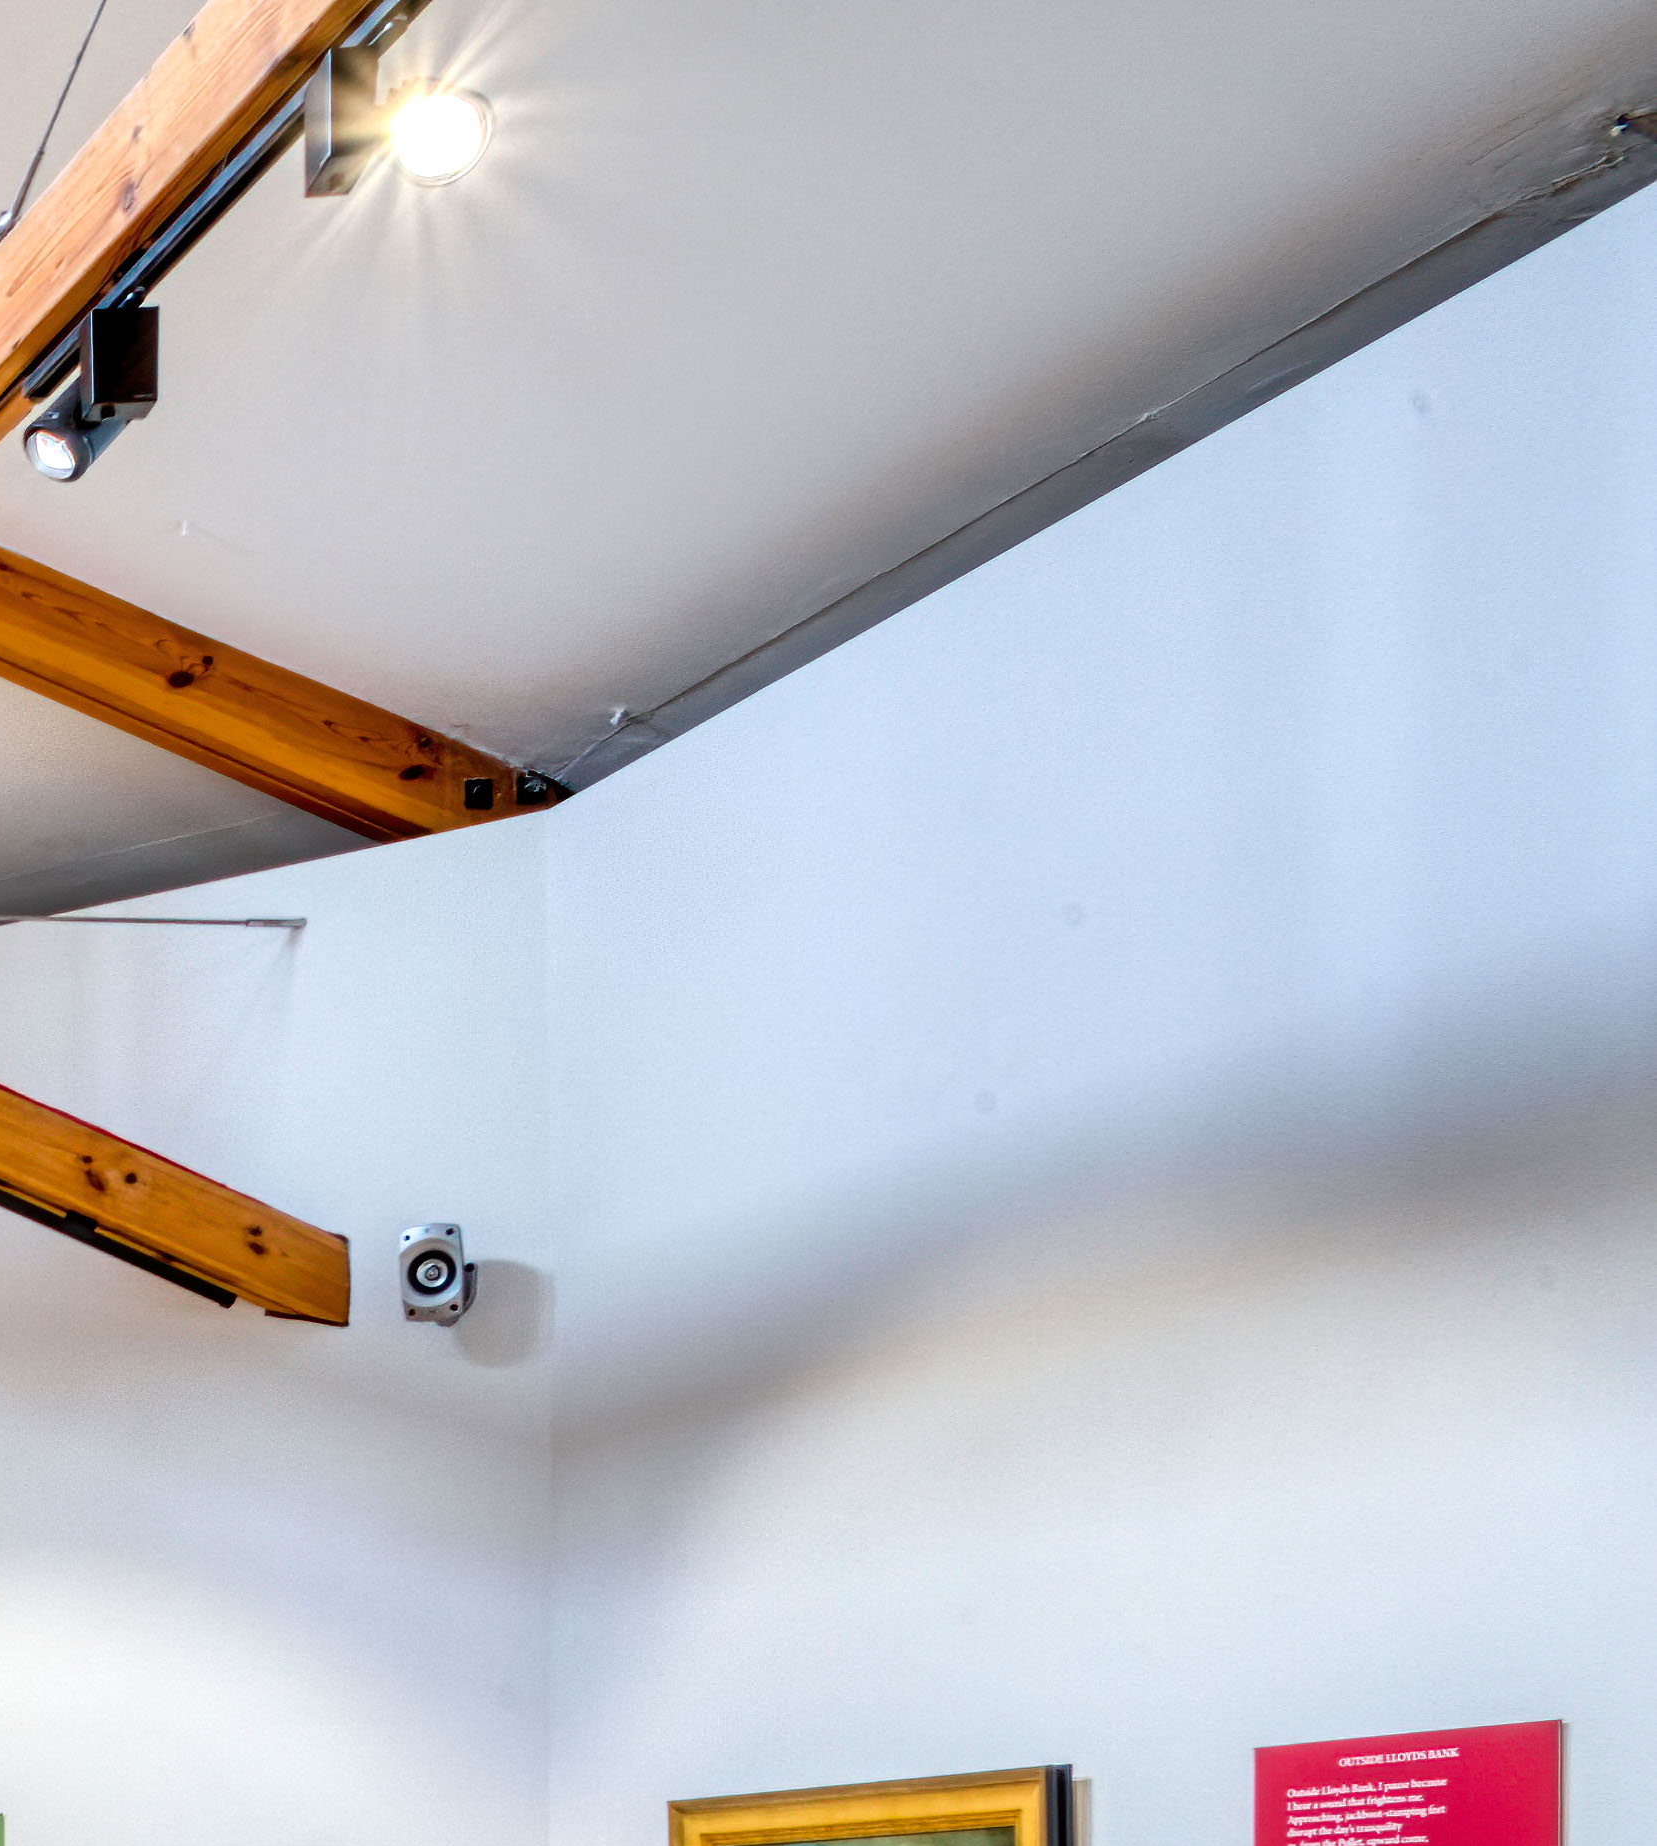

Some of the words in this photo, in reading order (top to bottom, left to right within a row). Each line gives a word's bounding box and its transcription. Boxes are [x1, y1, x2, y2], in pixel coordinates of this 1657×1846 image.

[1338, 1754, 1383, 1765] OUTSIDE
[1386, 1750, 1426, 1761] LLOYDS
[1428, 1747, 1458, 1757] BANK
